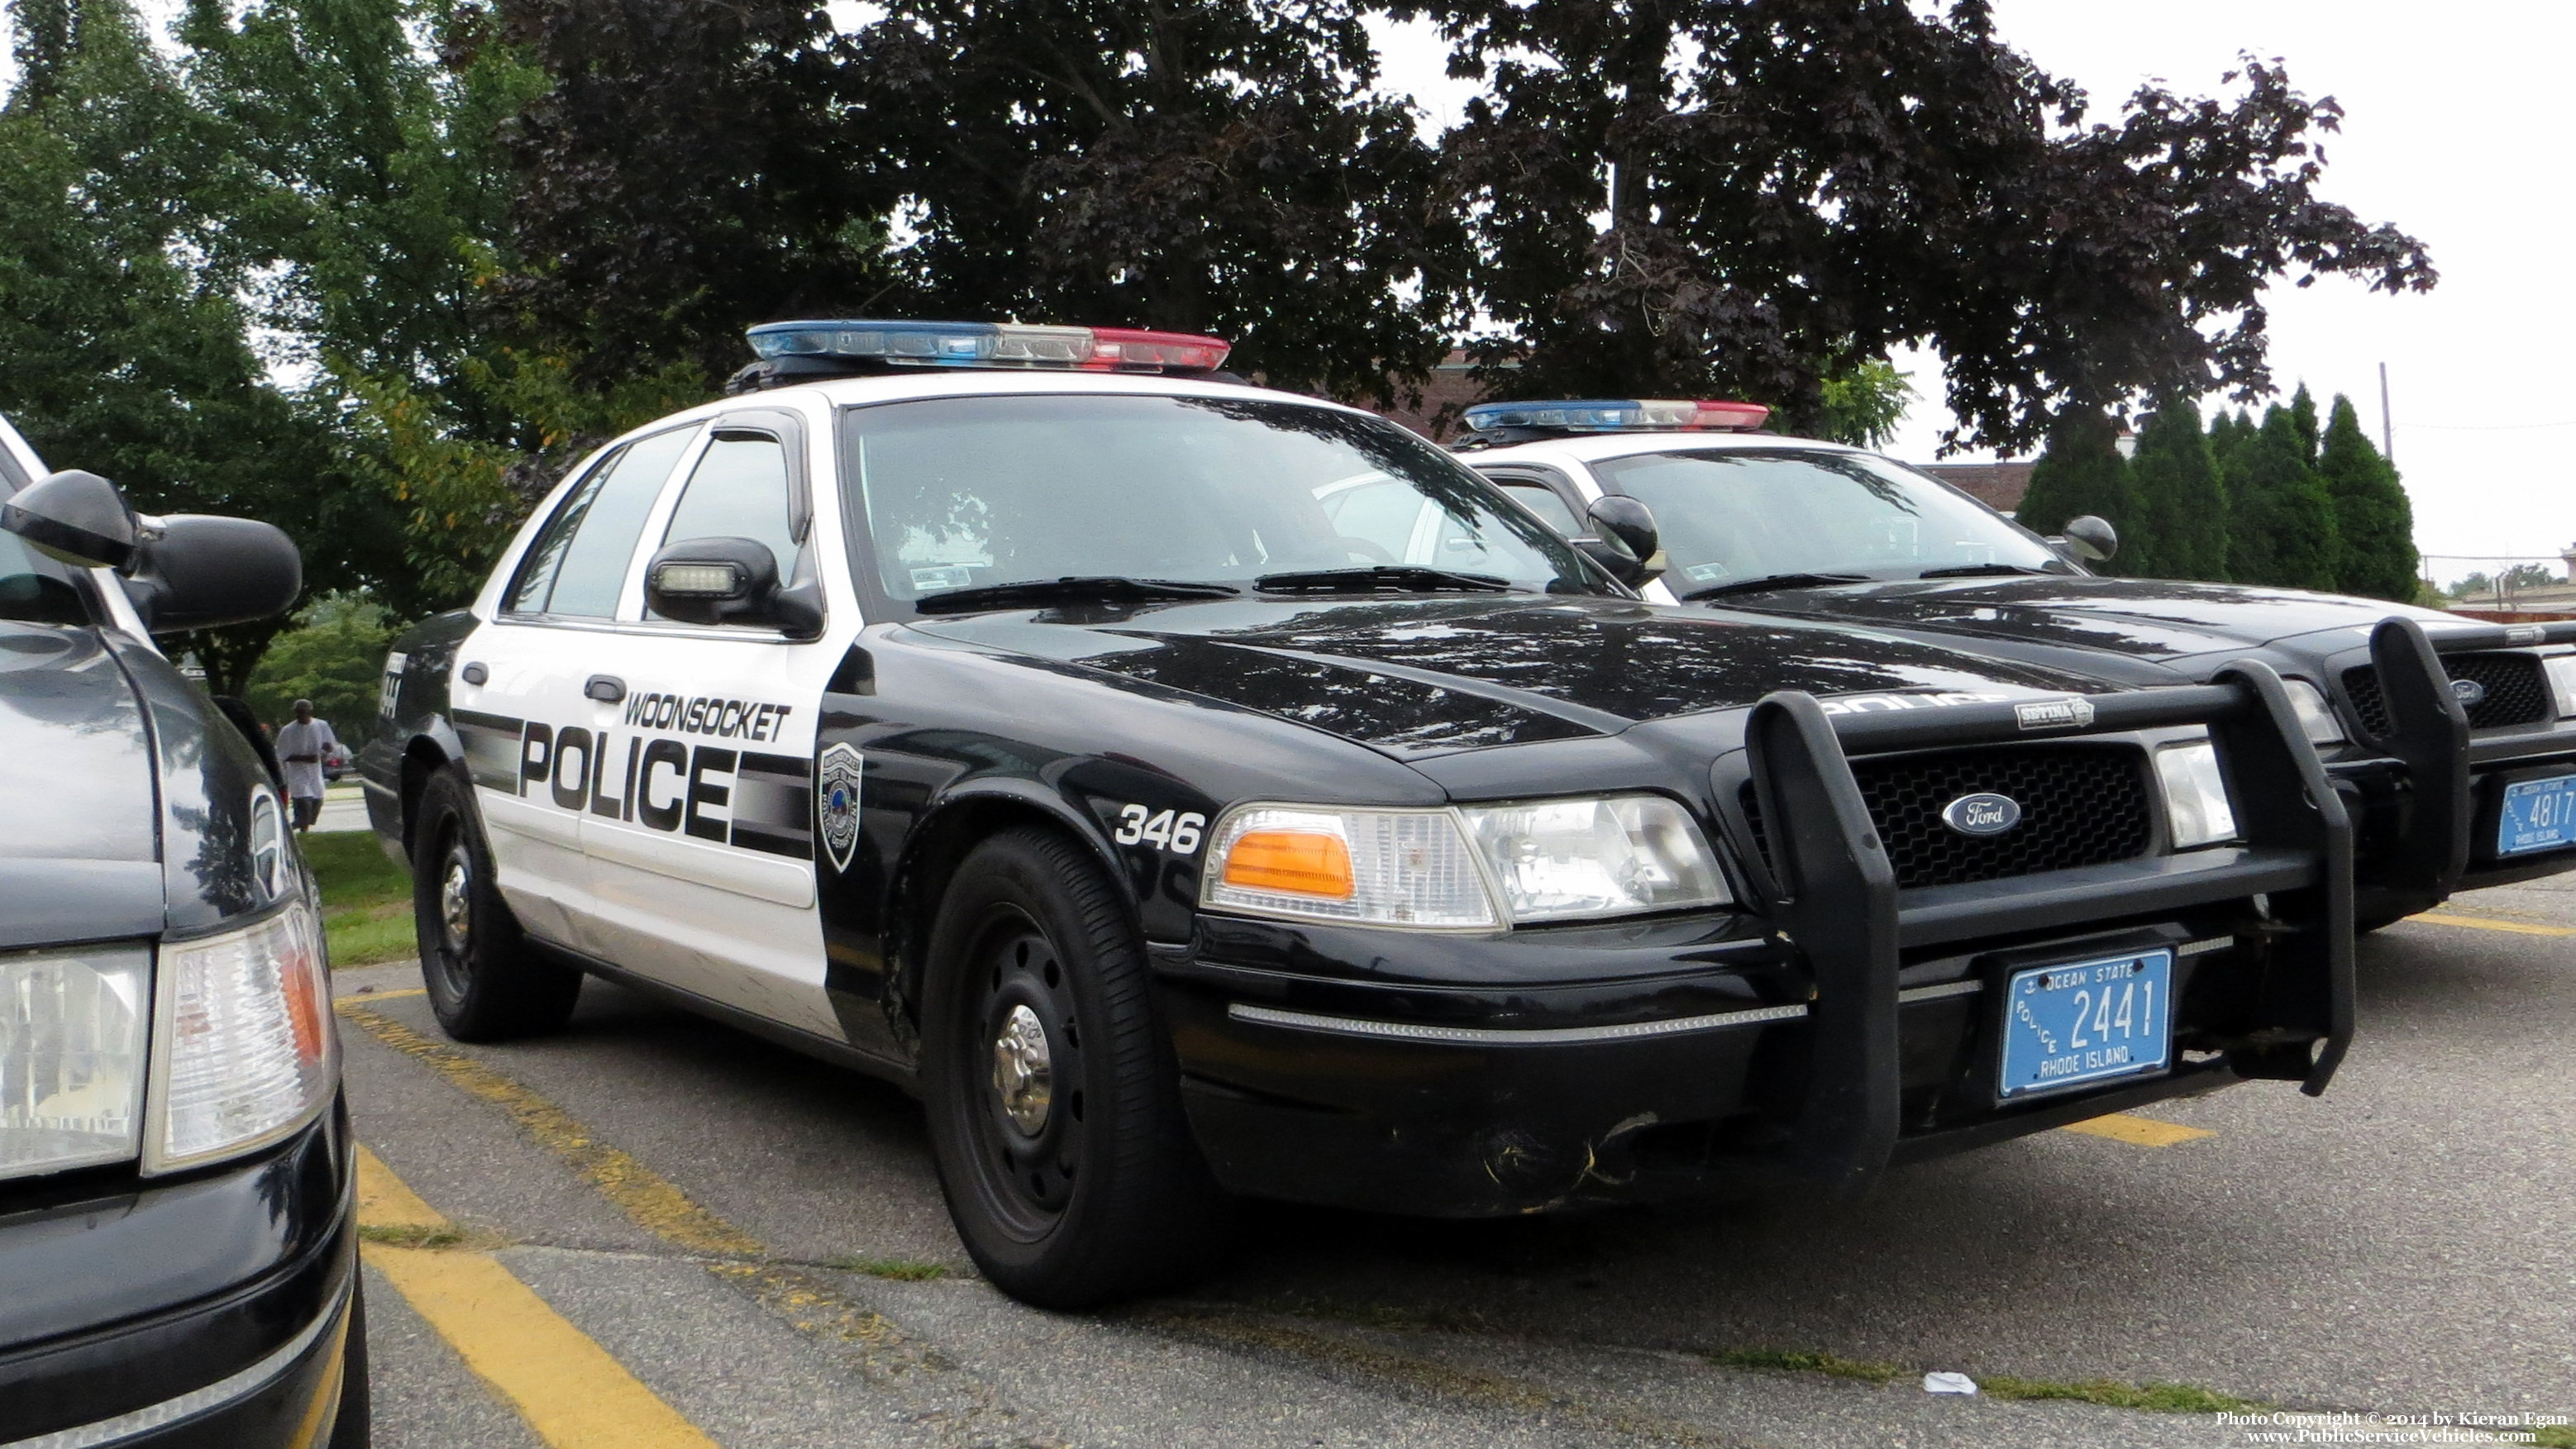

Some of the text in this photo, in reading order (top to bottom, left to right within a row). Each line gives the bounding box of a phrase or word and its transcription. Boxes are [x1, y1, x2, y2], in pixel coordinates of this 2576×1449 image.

[625, 692, 792, 742] WOONSOCKET
[519, 721, 738, 843] POLICE
[1115, 803, 1206, 855] 346
[1967, 802, 2005, 826] Ford
[2530, 791, 2575, 828] 4817
[2046, 963, 2134, 992] OCEAN STATE
[2016, 1000, 2057, 1054] POLICE
[2071, 980, 2153, 1049] 2441
[2039, 1046, 2129, 1079] RHODE ISLAND
